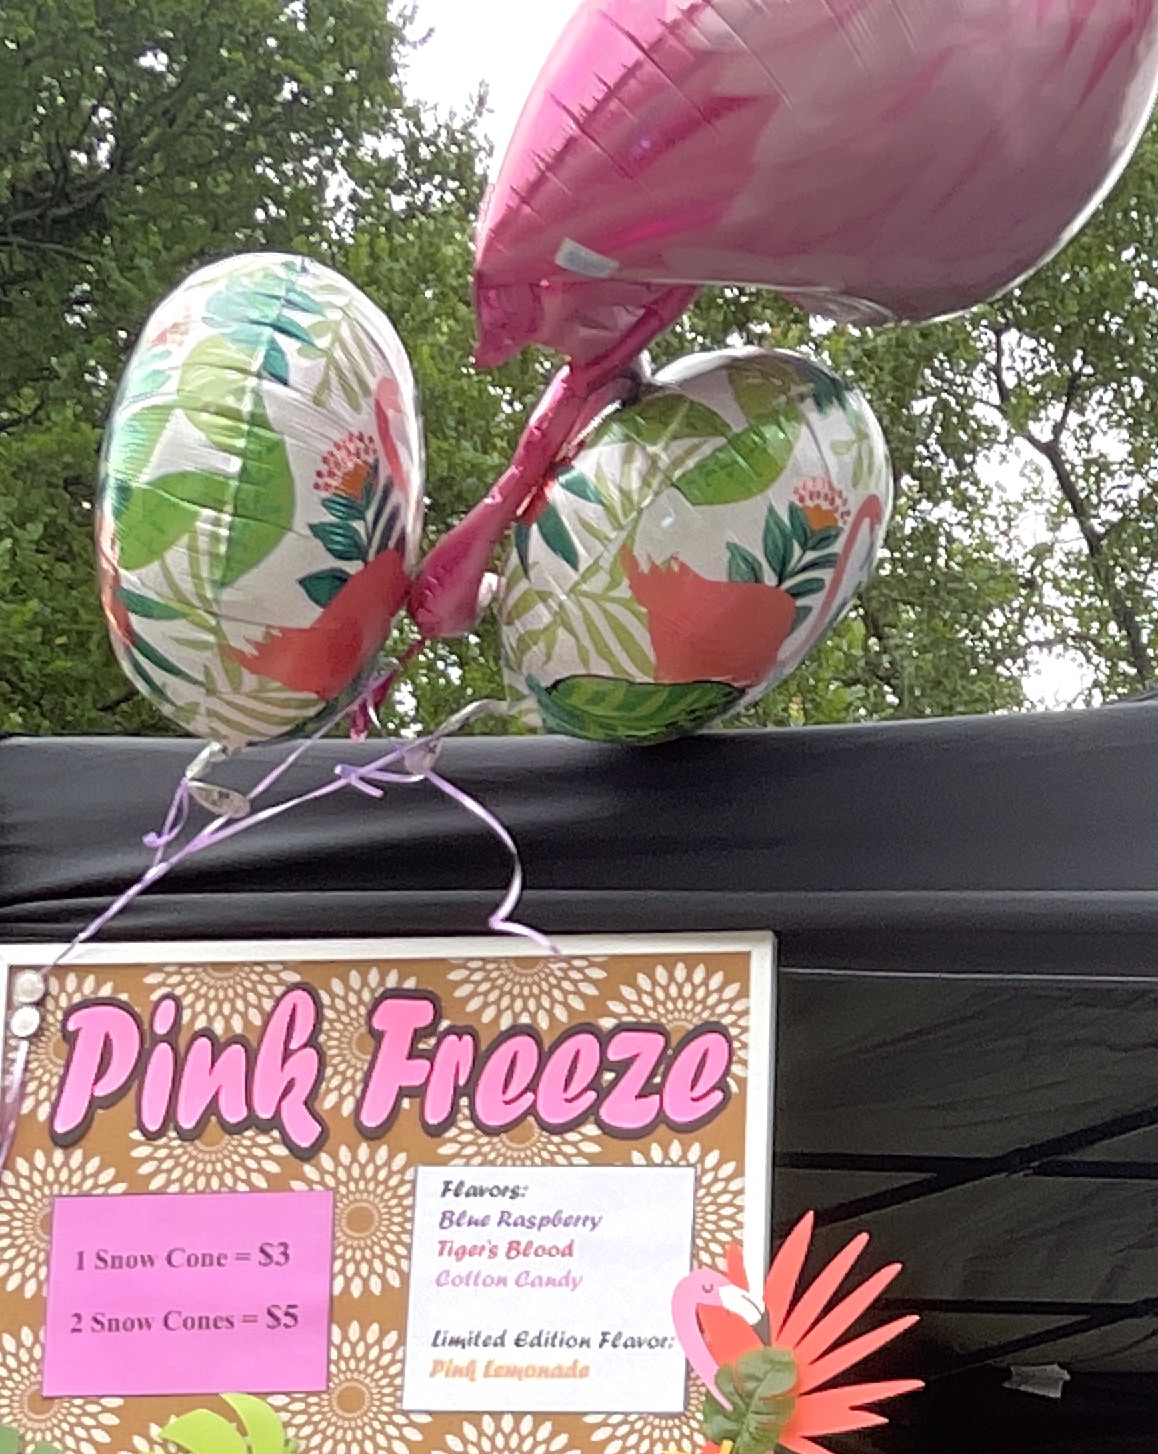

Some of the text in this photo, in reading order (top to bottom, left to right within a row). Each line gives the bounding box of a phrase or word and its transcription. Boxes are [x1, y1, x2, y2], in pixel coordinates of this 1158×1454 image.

[50, 986, 739, 1160] Pink Freeze
[440, 1180, 529, 1199] Flavors:
[438, 1209, 603, 1231] Blue Raspberry
[74, 1250, 86, 1271] 1
[94, 1249, 156, 1271] Snow
[166, 1247, 228, 1268] Cone
[258, 1241, 290, 1267] $3
[437, 1239, 575, 1262] Tiger's Blood
[435, 1268, 583, 1291] Cotton Candy
[71, 1312, 83, 1334] 2
[90, 1312, 153, 1333] Snow
[163, 1310, 235, 1331] Cones
[265, 1304, 299, 1330] $5
[431, 1329, 675, 1349] Limited Edition Flavor:
[429, 1358, 590, 1381] Pink Lemonade
